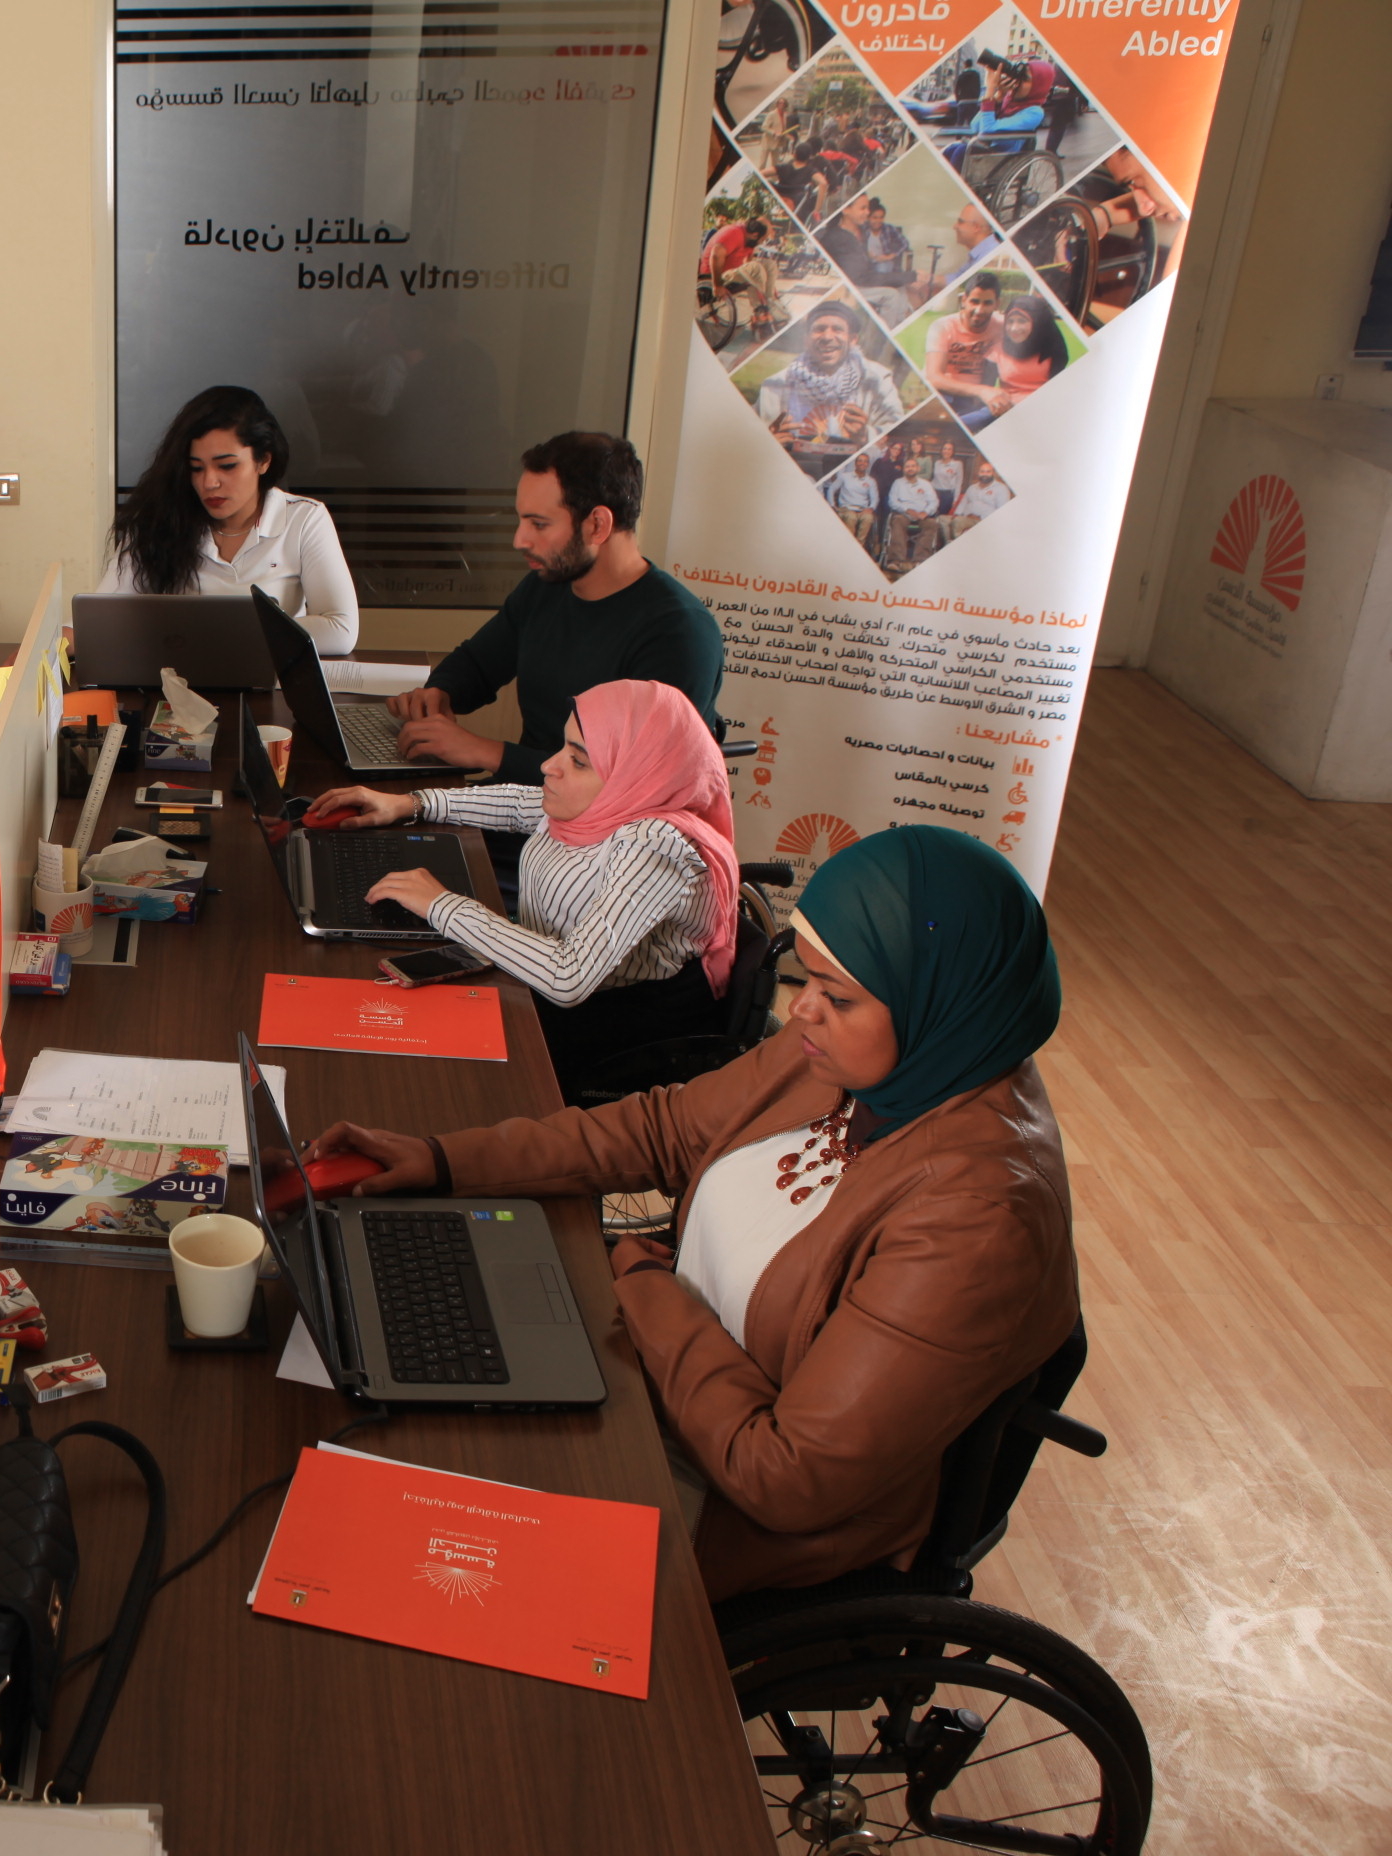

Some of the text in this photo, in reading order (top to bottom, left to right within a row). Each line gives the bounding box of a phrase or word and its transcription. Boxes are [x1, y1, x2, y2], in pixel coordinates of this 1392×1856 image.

[840, 0, 950, 27] قادرون
[1039, 0, 1229, 23] Differently
[859, 33, 945, 53] باختلاف
[1120, 30, 1223, 57] Abled
[683, 567, 748, 590] باختلاف
[753, 575, 828, 597] القادرون
[831, 588, 879, 602] لدمج
[883, 590, 949, 612] الحسن
[716, 601, 747, 613] العمر
[750, 604, 769, 615] من
[954, 599, 1034, 624] مؤسسة
[724, 616, 741, 628] مع
[797, 610, 818, 624] في
[822, 613, 856, 627] بشاب
[1040, 611, 1087, 629] لماذا
[752, 621, 793, 634] الحسن
[803, 627, 833, 641] والدة
[908, 625, 933, 637] عام
[937, 628, 959, 641] في
[822, 647, 829, 657] و
[1014, 637, 1051, 652] حادث
[957, 649, 1005, 664] لكرسي
[795, 659, 837, 673] اصحاب
[943, 665, 996, 679] الكراسي
[1014, 657, 1077, 672] مستخدم
[750, 667, 782, 680] لدمج
[783, 672, 824, 686] الحسن
[880, 670, 906, 684] التي
[828, 676, 877, 695] مؤسسة
[1001, 674, 1073, 689] مستخدمي
[880, 683, 913, 700] طريق
[916, 689, 936, 702] عن
[974, 684, 1032, 701] المصاعب
[984, 702, 1025, 716] الشرق
[1027, 707, 1036, 721] و
[1038, 710, 1066, 722] مصر
[844, 735, 883, 751] مصريه
[965, 723, 1050, 749] مشاريعنا
[947, 752, 954, 763] و
[957, 753, 995, 770] بيانات
[895, 769, 990, 793] كرسي بالمقاس
[893, 794, 985, 819] توصيله مجهزه
[160, 1180, 217, 1201] Fine
[446, 1500, 464, 1510] يوم
[428, 1536, 498, 1557] الحسن
[427, 1546, 496, 1569] مؤسسة
